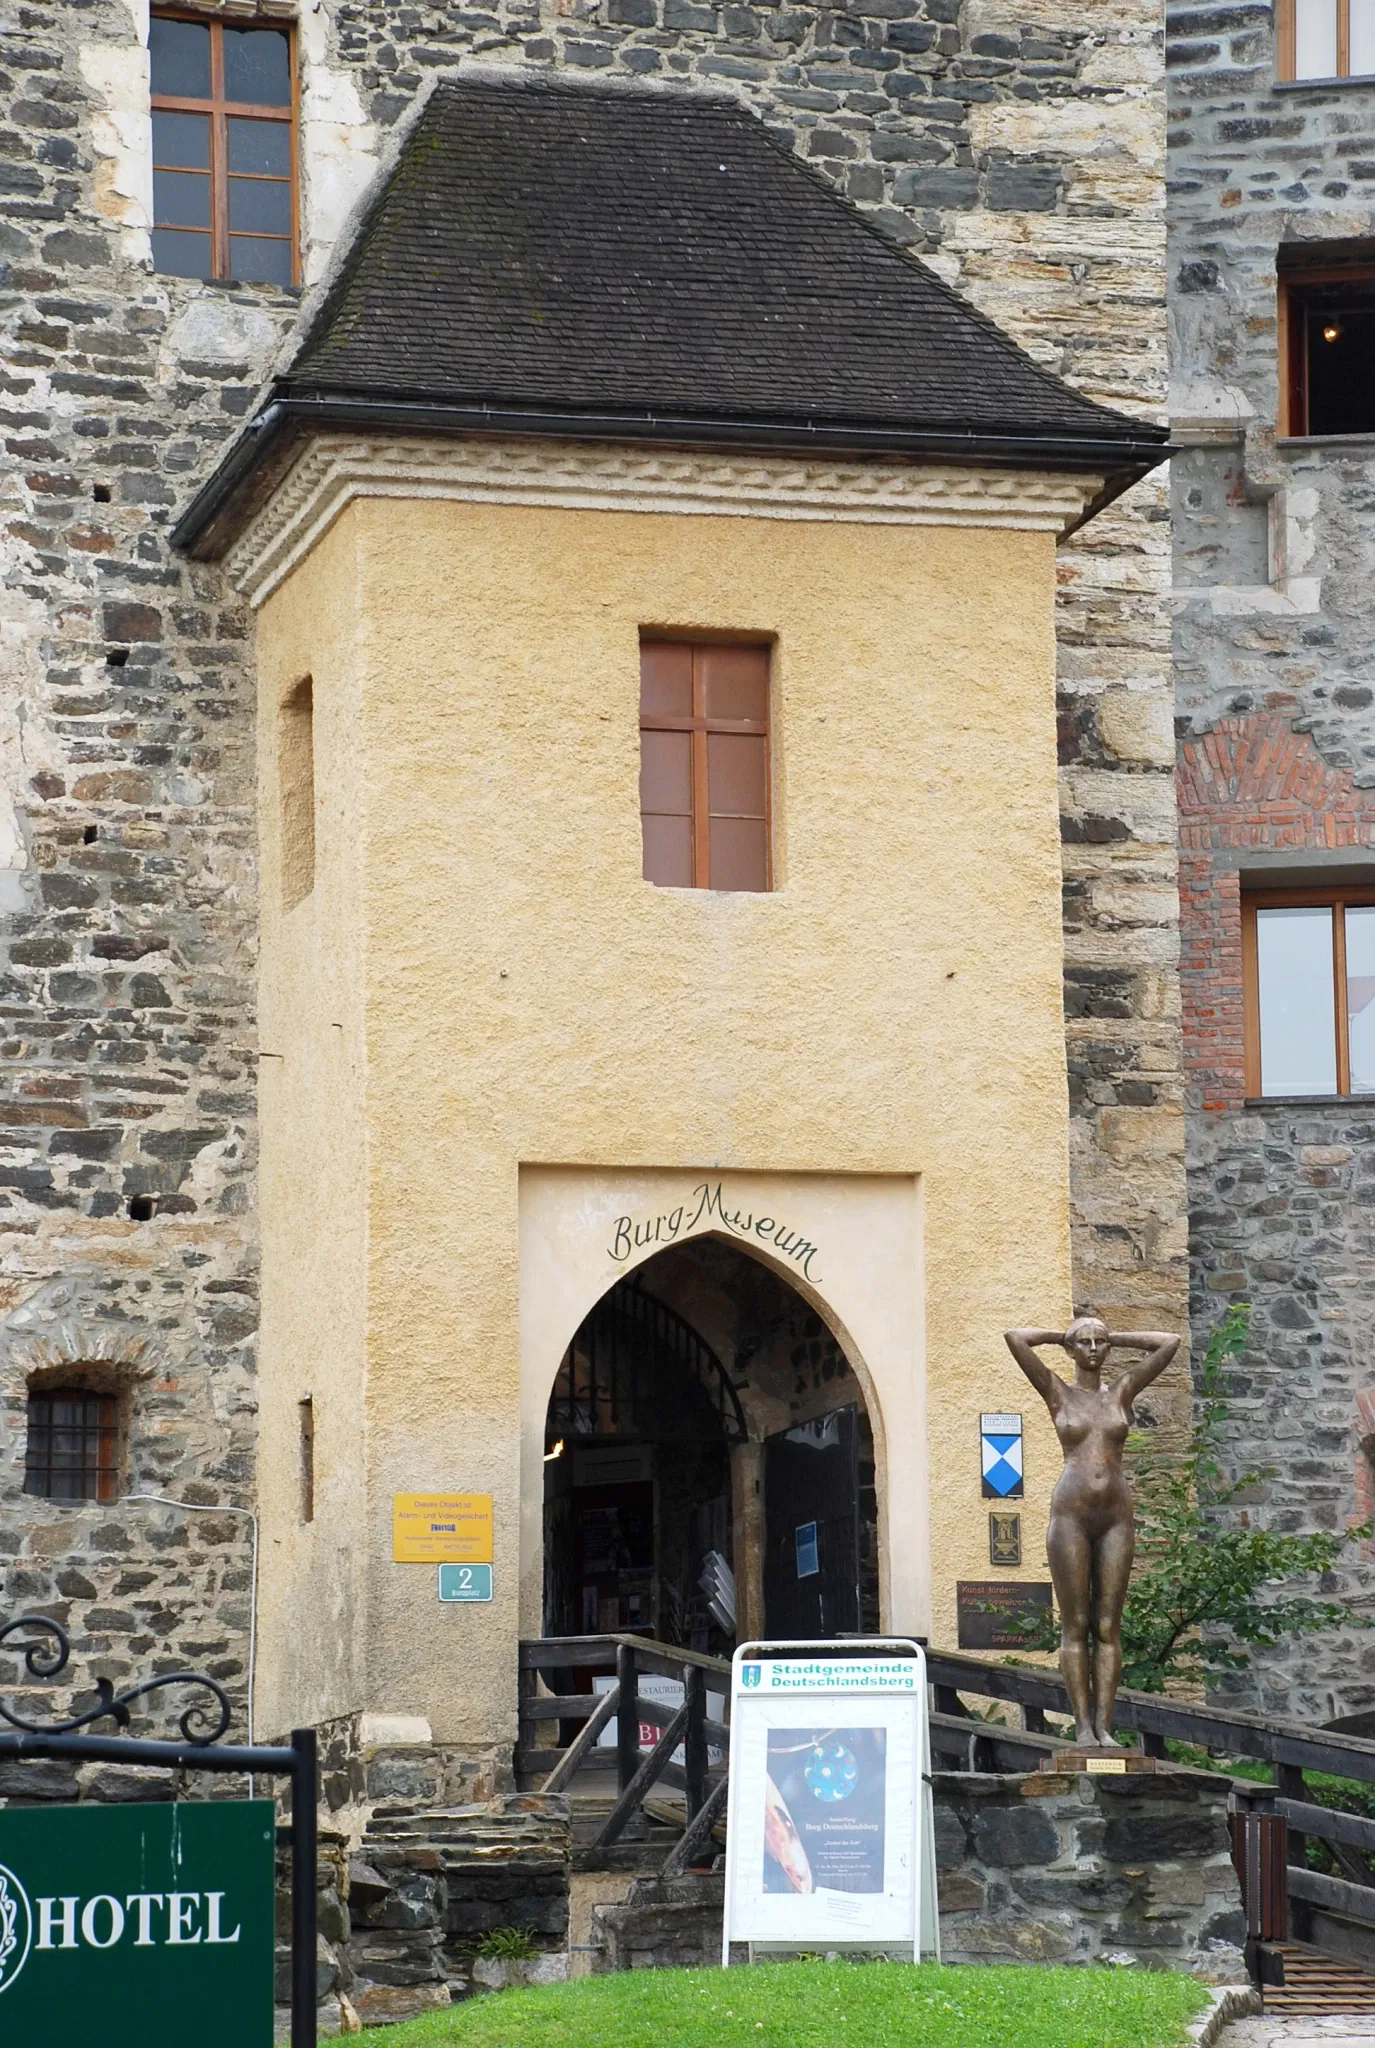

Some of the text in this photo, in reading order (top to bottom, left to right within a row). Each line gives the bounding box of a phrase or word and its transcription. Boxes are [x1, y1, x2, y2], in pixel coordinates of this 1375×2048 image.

[607, 1182, 823, 1284] Burg-Museum
[459, 1567, 473, 1589] 2
[962, 1585, 985, 1594] Kunst
[772, 1664, 913, 1676] Stadtgemeinde
[771, 1676, 914, 1688] Deutschlandsberg
[805, 1823, 879, 1832] Burg Deutschlandsberg
[35, 1892, 241, 1949] HOTEL
